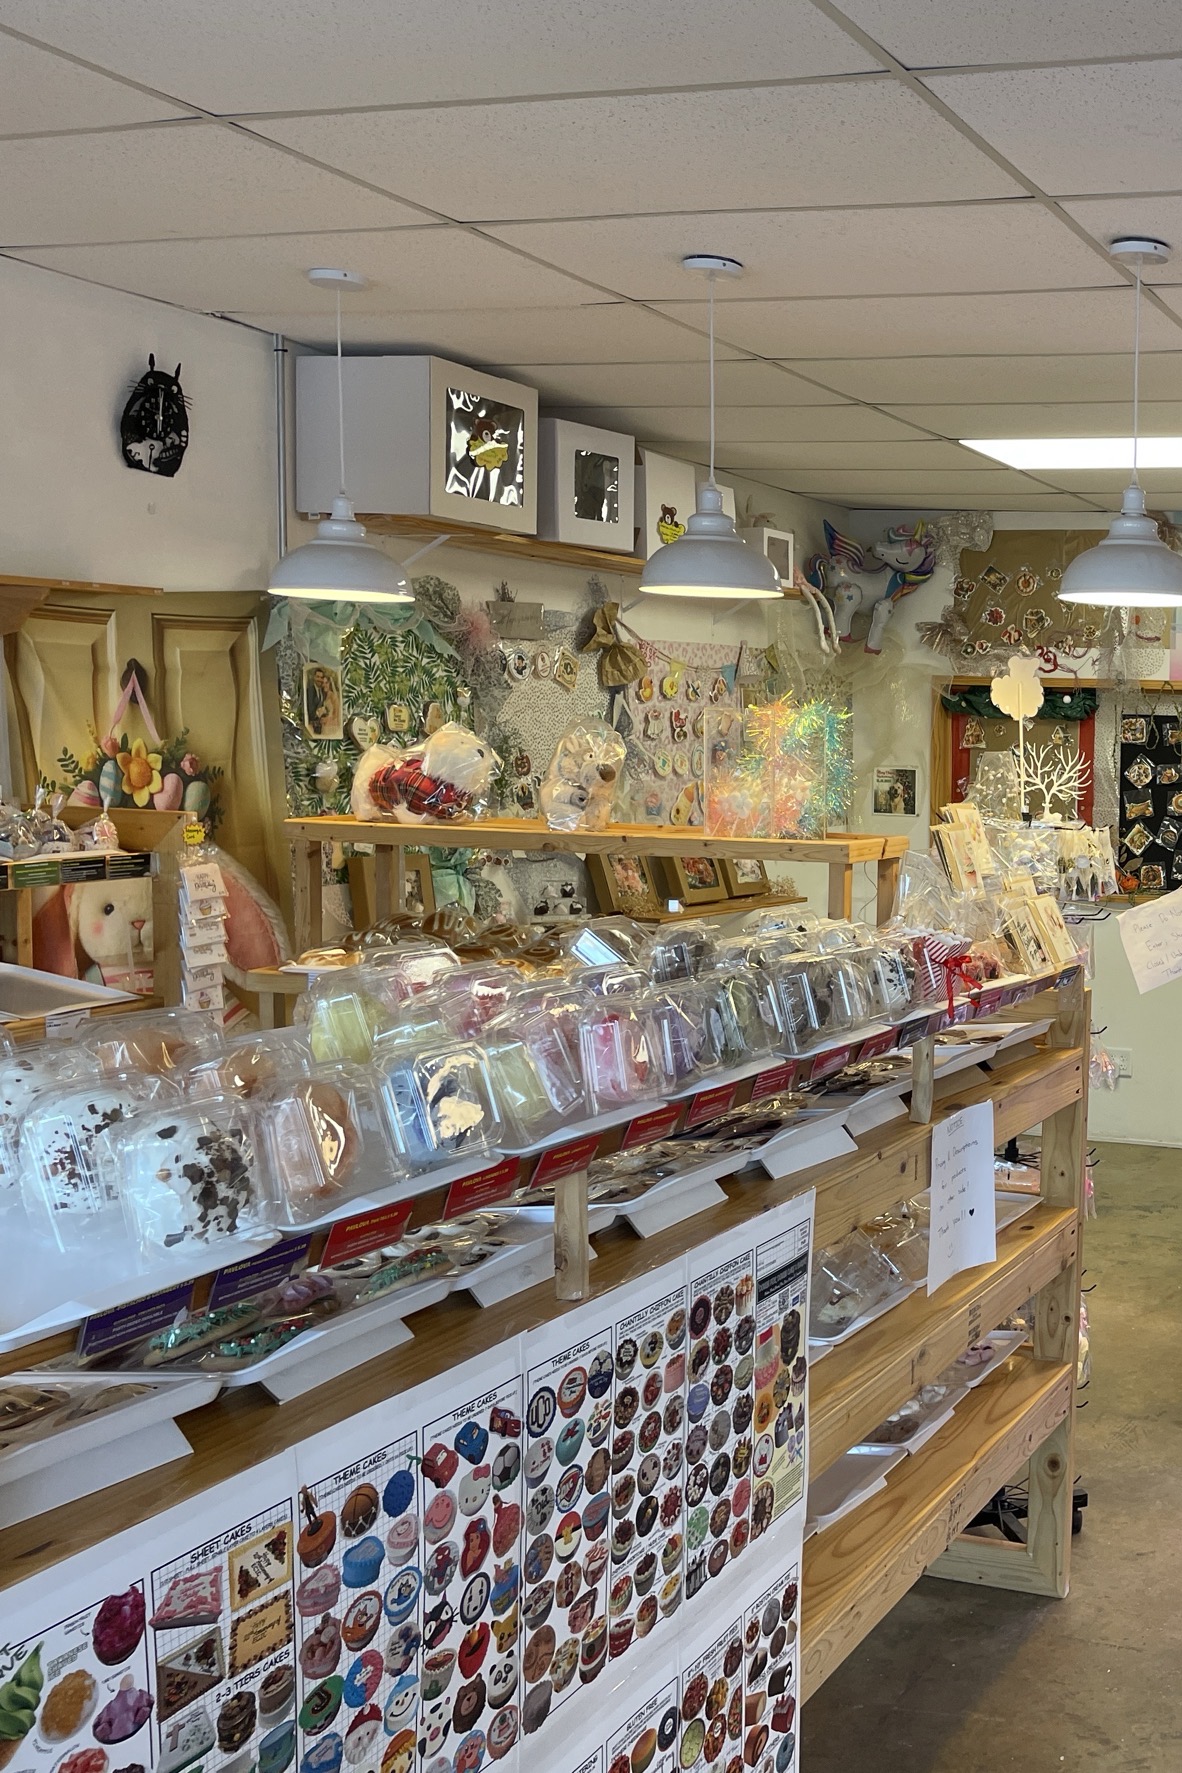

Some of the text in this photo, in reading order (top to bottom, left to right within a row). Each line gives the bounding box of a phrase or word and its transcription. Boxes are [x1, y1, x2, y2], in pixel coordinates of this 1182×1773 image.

[1132, 923, 1152, 933] Please
[1158, 912, 1168, 923] Do
[1145, 940, 1168, 952] Enter,
[1146, 958, 1165, 970] Closed
[1161, 967, 1182, 977] Thank
[946, 1116, 963, 1134] NOTICE
[619, 1310, 649, 1331] CHANTILLY
[672, 1289, 684, 1302] CAKE
[551, 1341, 591, 1368] THEME CAKES
[451, 1402, 476, 1422] THEME
[476, 1391, 498, 1408] CAKES
[332, 1450, 388, 1485] THEME CAKES
[190, 1523, 252, 1564] SHEET CAKES
[215, 1648, 290, 1704] 2-3 TIERS CAKES
[626, 1707, 647, 1732] GLUTEN
